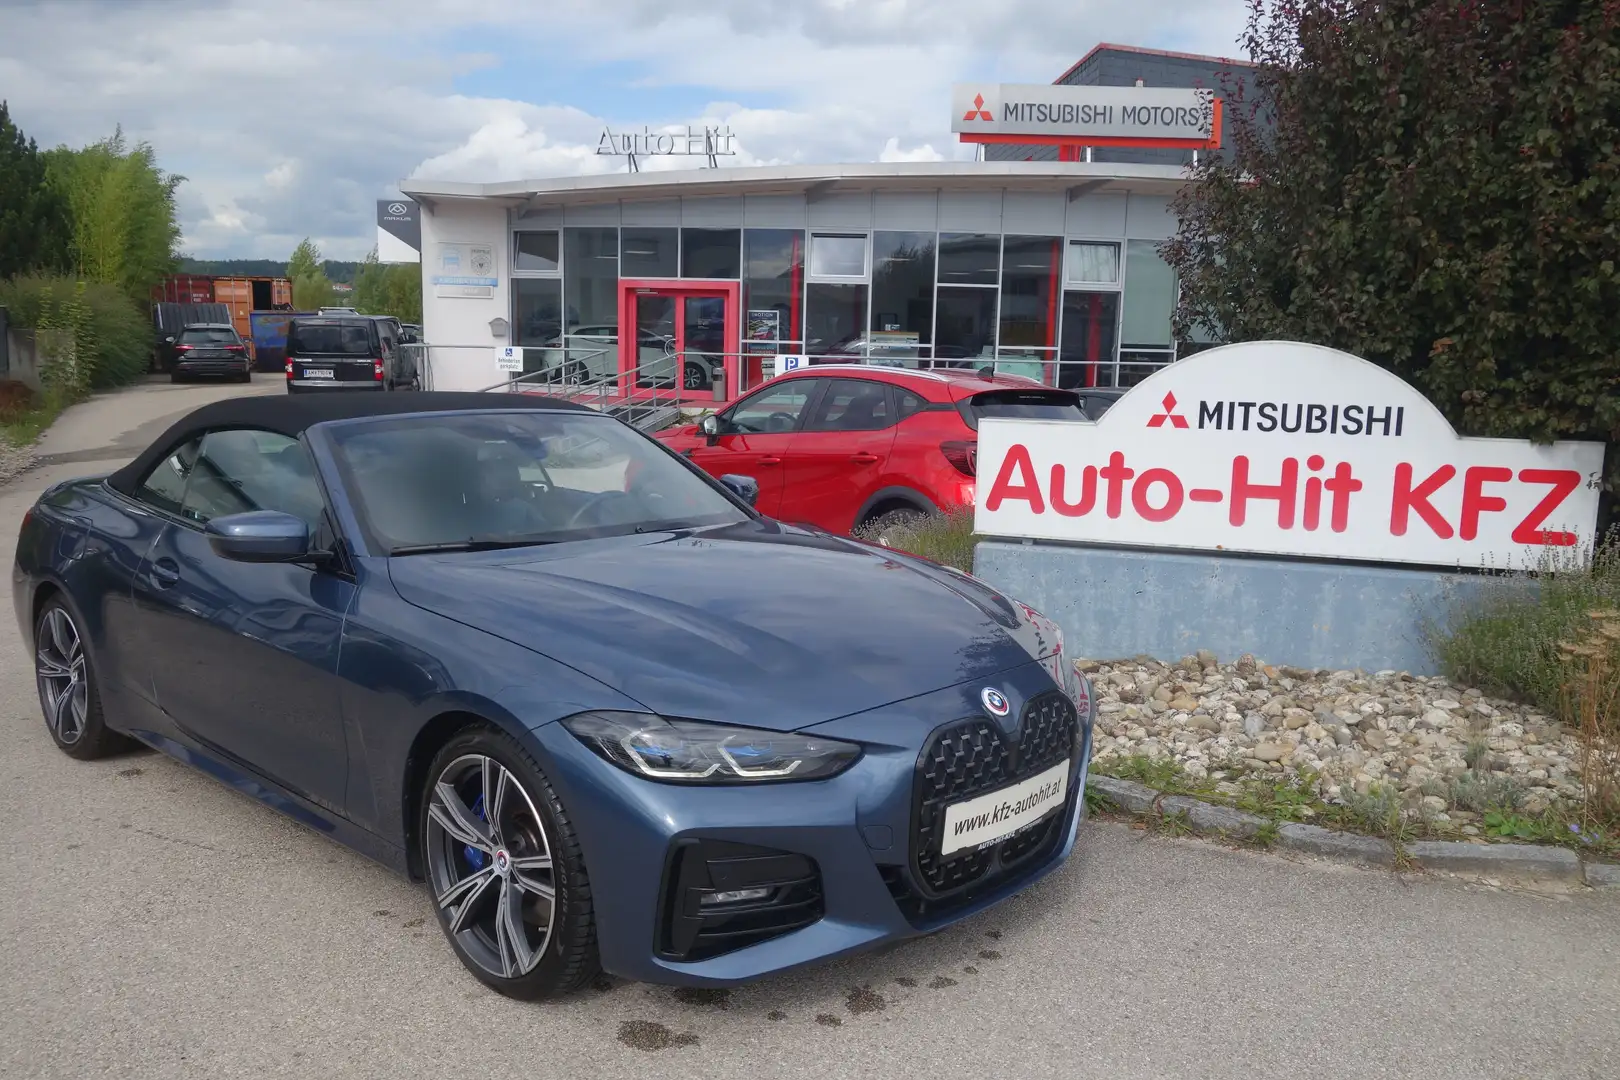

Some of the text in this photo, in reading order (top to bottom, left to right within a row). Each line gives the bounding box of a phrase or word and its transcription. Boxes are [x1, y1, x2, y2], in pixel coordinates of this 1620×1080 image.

[1004, 102, 1199, 127] MITSUBISHI MOTORS
[596, 125, 736, 155] Auto Hit
[1198, 400, 1404, 437] MITSUBISHI
[985, 443, 1583, 547] Auto-Hit KFZ
[954, 778, 1062, 836] www.kfz-autohit.at
